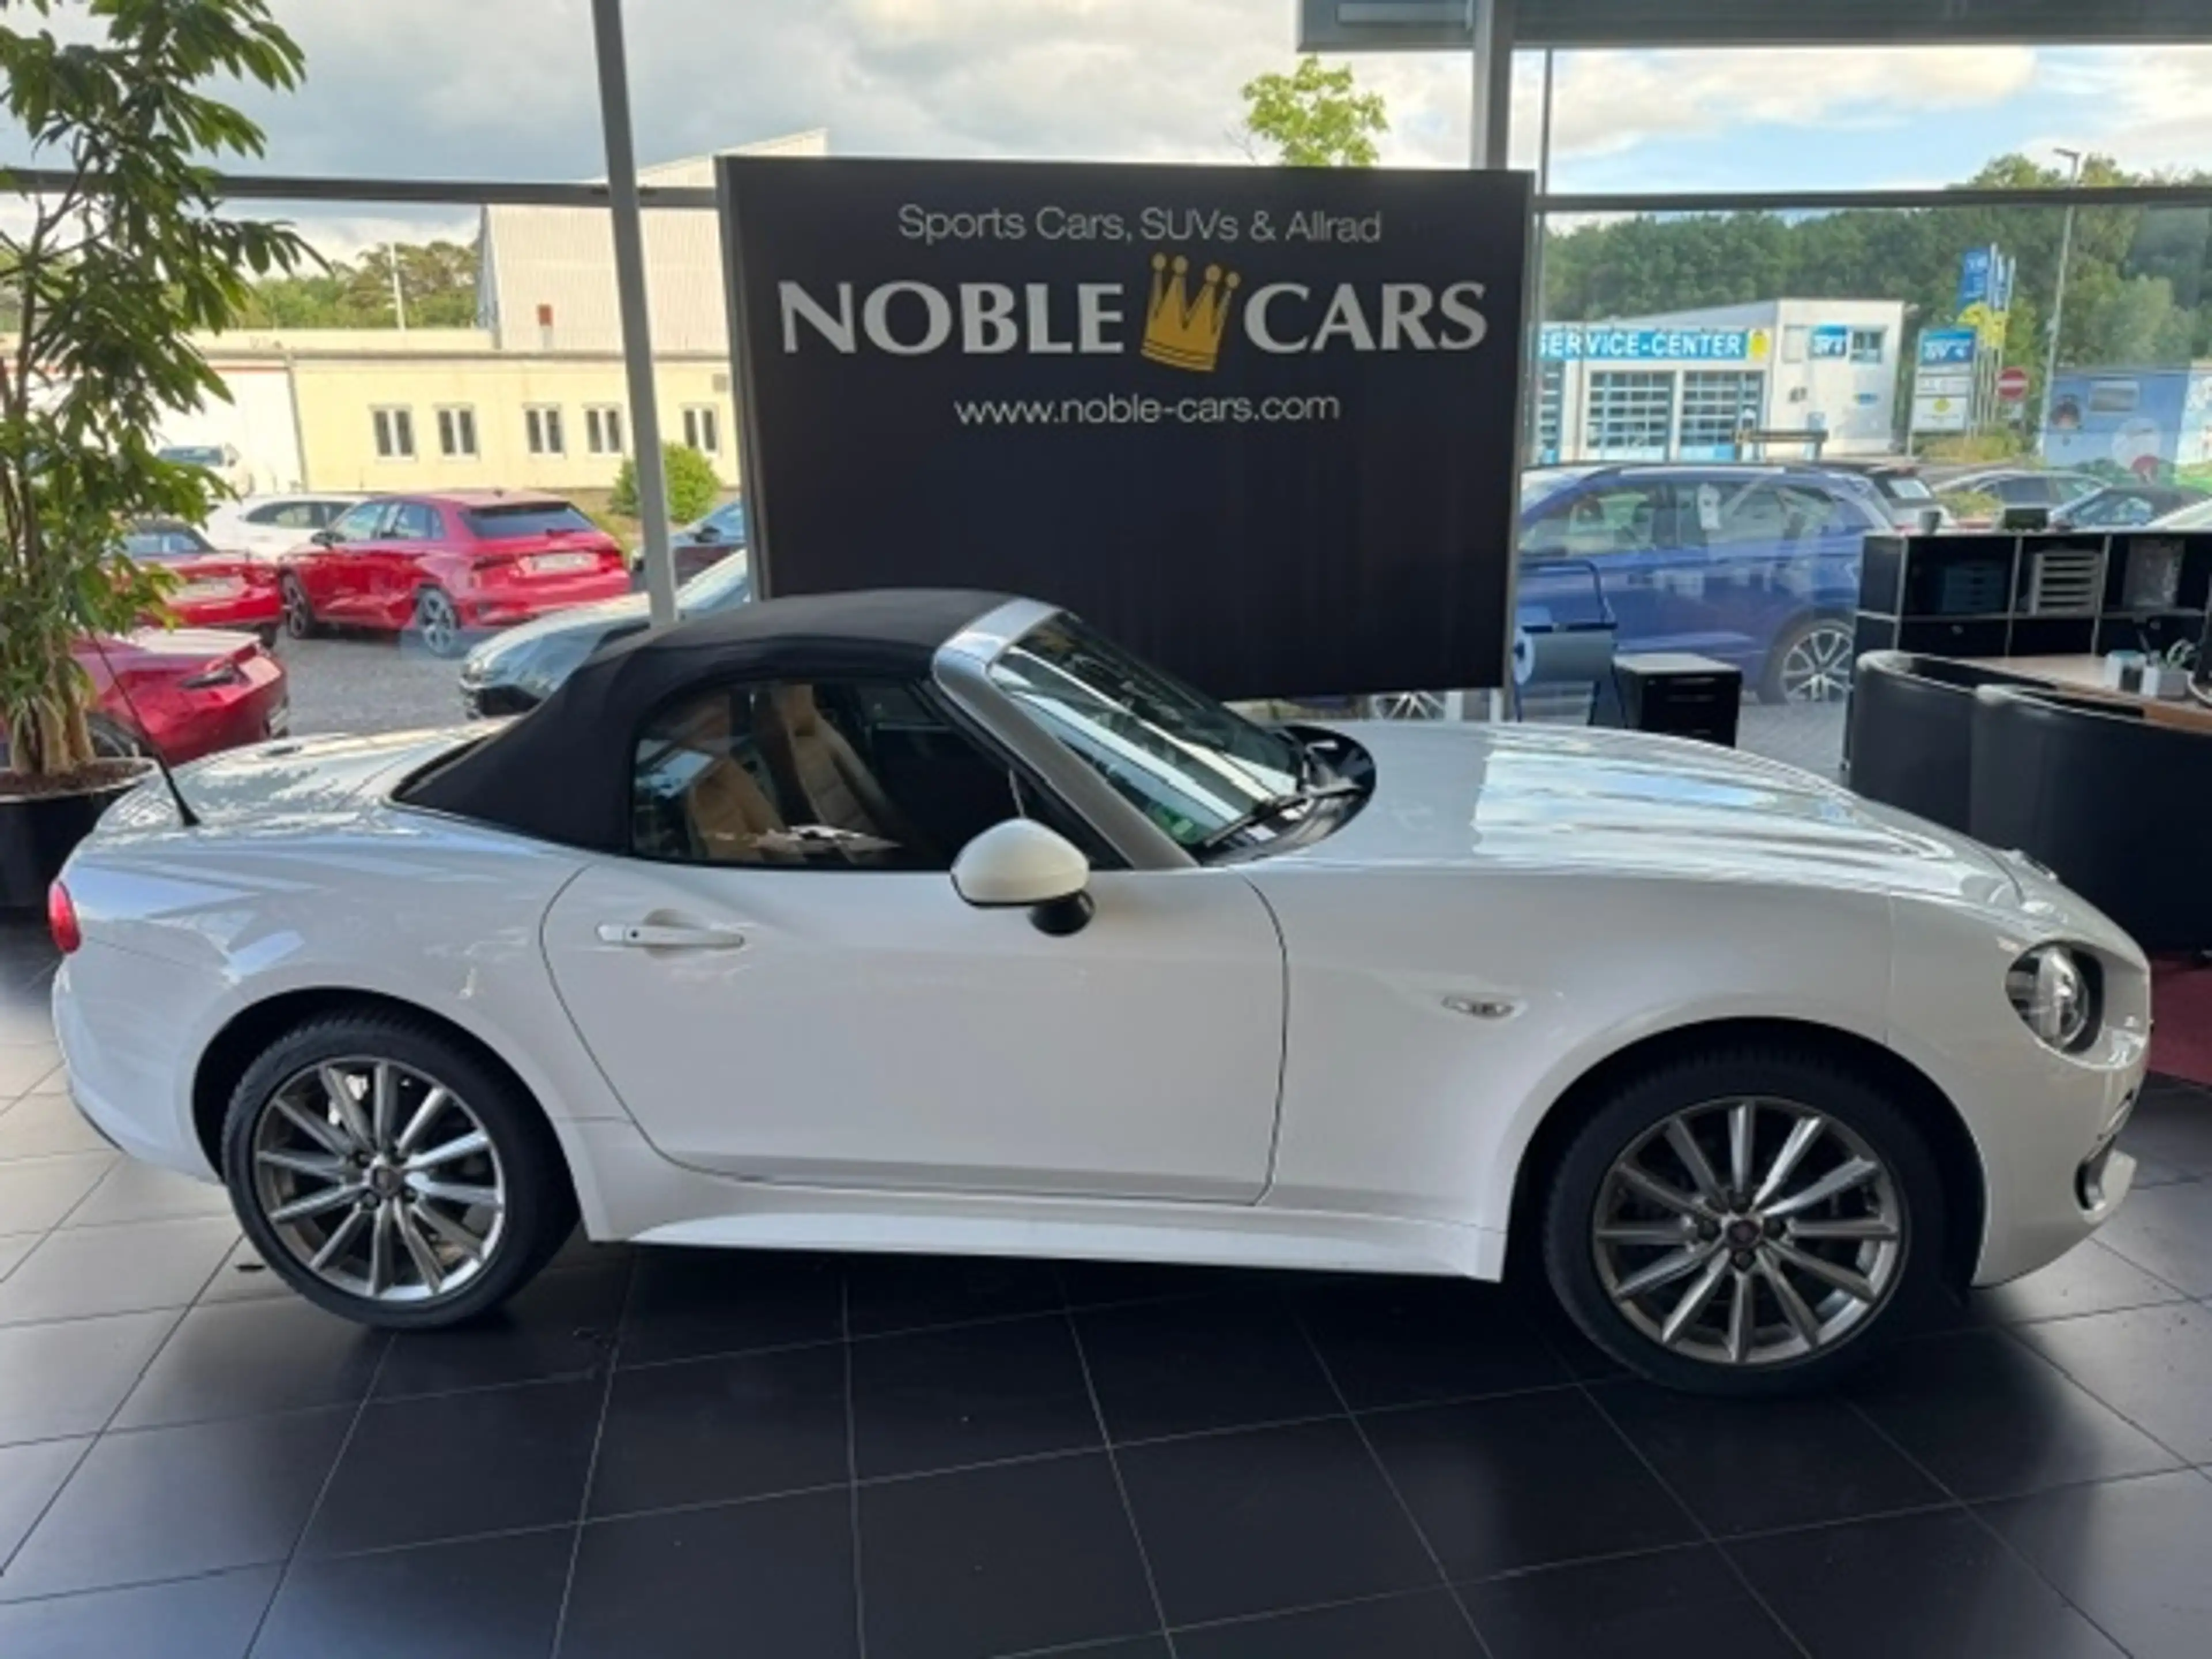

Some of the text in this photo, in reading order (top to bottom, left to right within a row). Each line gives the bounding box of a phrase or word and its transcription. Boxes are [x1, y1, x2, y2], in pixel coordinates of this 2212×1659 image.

[899, 203, 1380, 243] Sports Cars, SUVs & Allrad
[778, 281, 1486, 354] NOBLE CARS
[954, 393, 1339, 425] www.noble-cars.com
